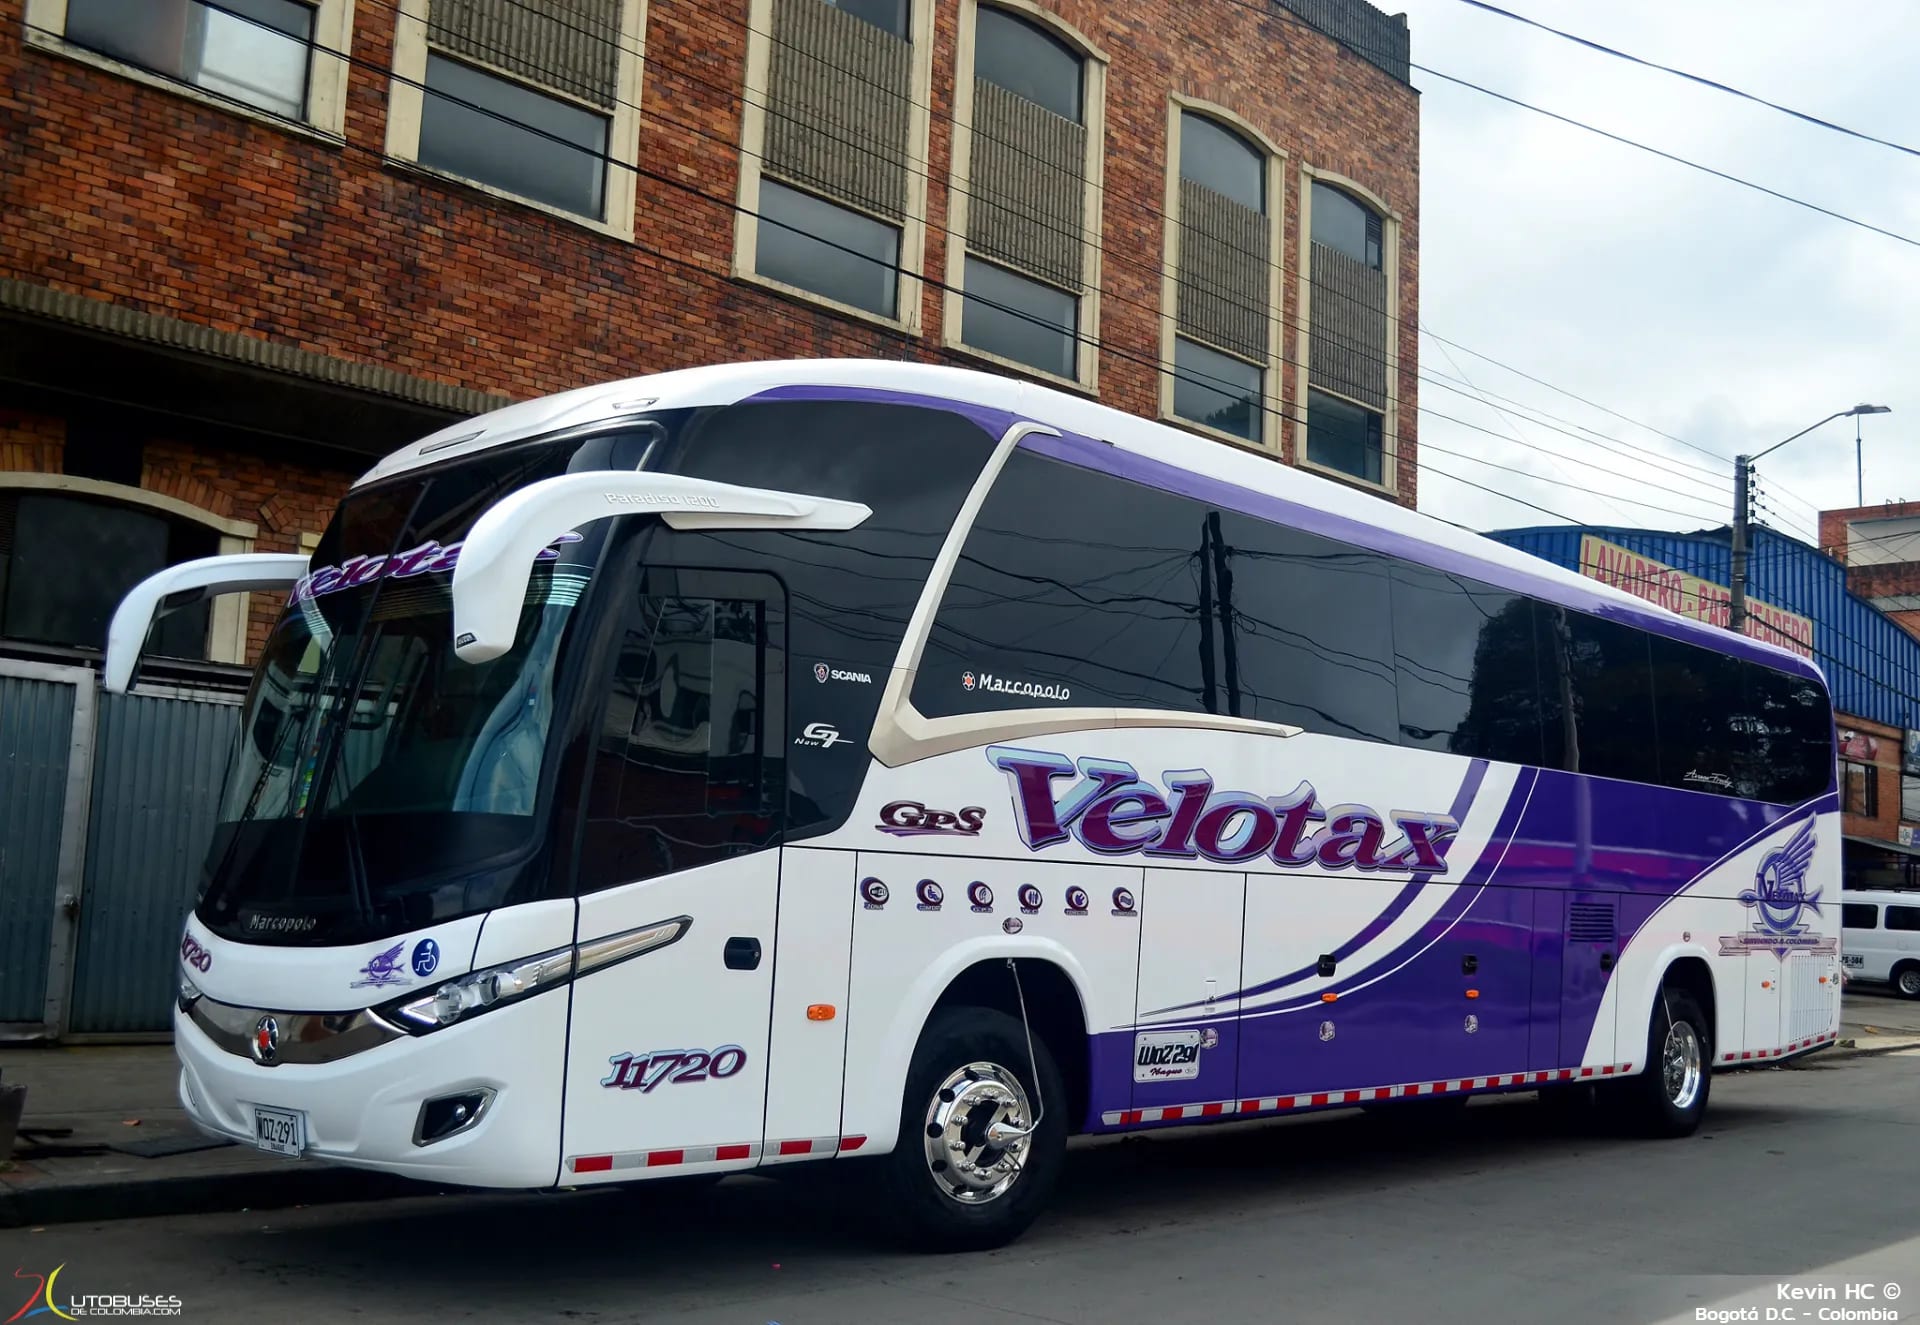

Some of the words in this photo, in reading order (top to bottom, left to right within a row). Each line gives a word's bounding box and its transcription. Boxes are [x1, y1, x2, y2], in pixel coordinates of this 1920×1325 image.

[1582, 539, 1684, 615] LAVADERO
[1697, 583, 1810, 659] PARUEADERO
[831, 669, 872, 684] SCANIA
[979, 673, 1070, 701] Marcopolo
[879, 799, 987, 832] GPS
[985, 745, 1462, 875] Velotax
[249, 914, 317, 932] Marcopolo
[600, 1044, 747, 1094] 11720
